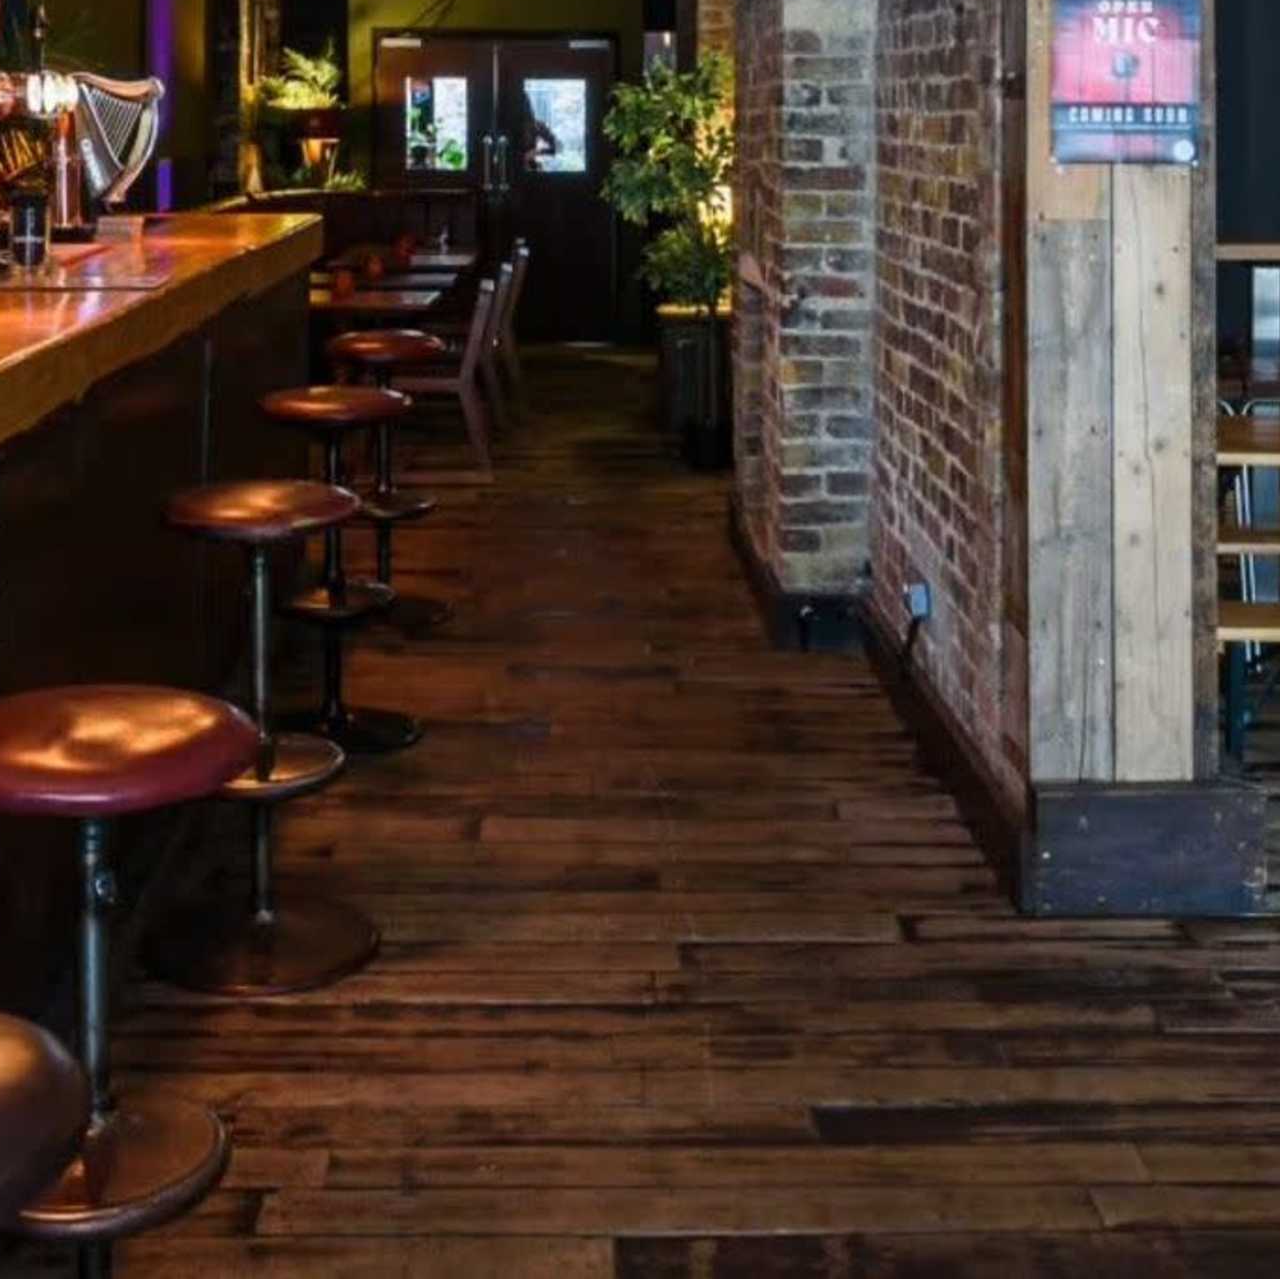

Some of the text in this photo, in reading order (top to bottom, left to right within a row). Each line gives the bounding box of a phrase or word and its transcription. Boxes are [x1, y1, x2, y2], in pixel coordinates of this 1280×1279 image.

[1097, 0, 1152, 13] OPEN
[1092, 17, 1160, 45] MIC
[1068, 107, 1187, 123] COMING SOON
